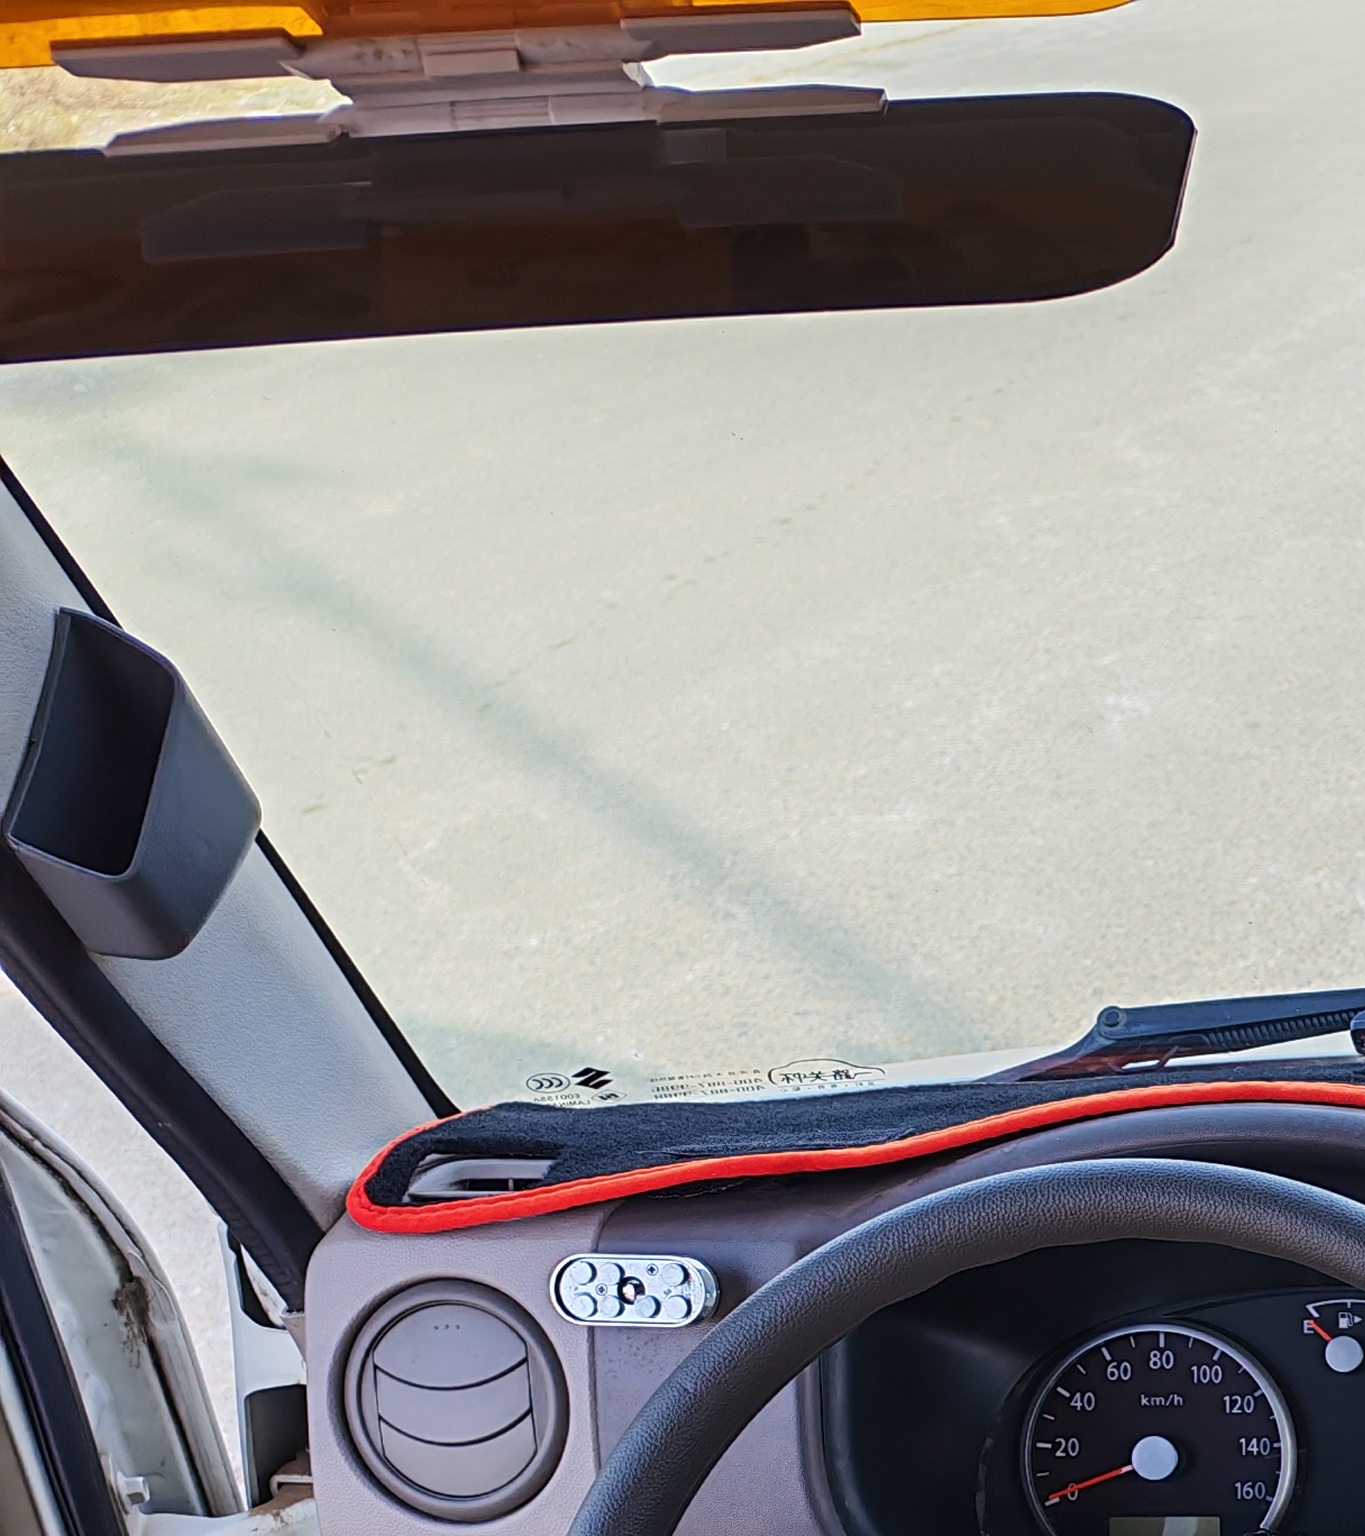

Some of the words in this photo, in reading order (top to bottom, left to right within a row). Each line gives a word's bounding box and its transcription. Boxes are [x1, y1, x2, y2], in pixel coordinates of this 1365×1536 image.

[1303, 1320, 1315, 1334] E
[1149, 1350, 1175, 1370] 80
[1106, 1361, 1132, 1381] 60
[1190, 1365, 1223, 1384] 100
[1070, 1392, 1096, 1411] 40
[1140, 1394, 1184, 1407] km/h
[1222, 1395, 1255, 1414] 120
[1054, 1438, 1080, 1457] 20
[1239, 1438, 1271, 1456] 140
[1067, 1482, 1079, 1501] 0
[1234, 1482, 1266, 1501] 160
